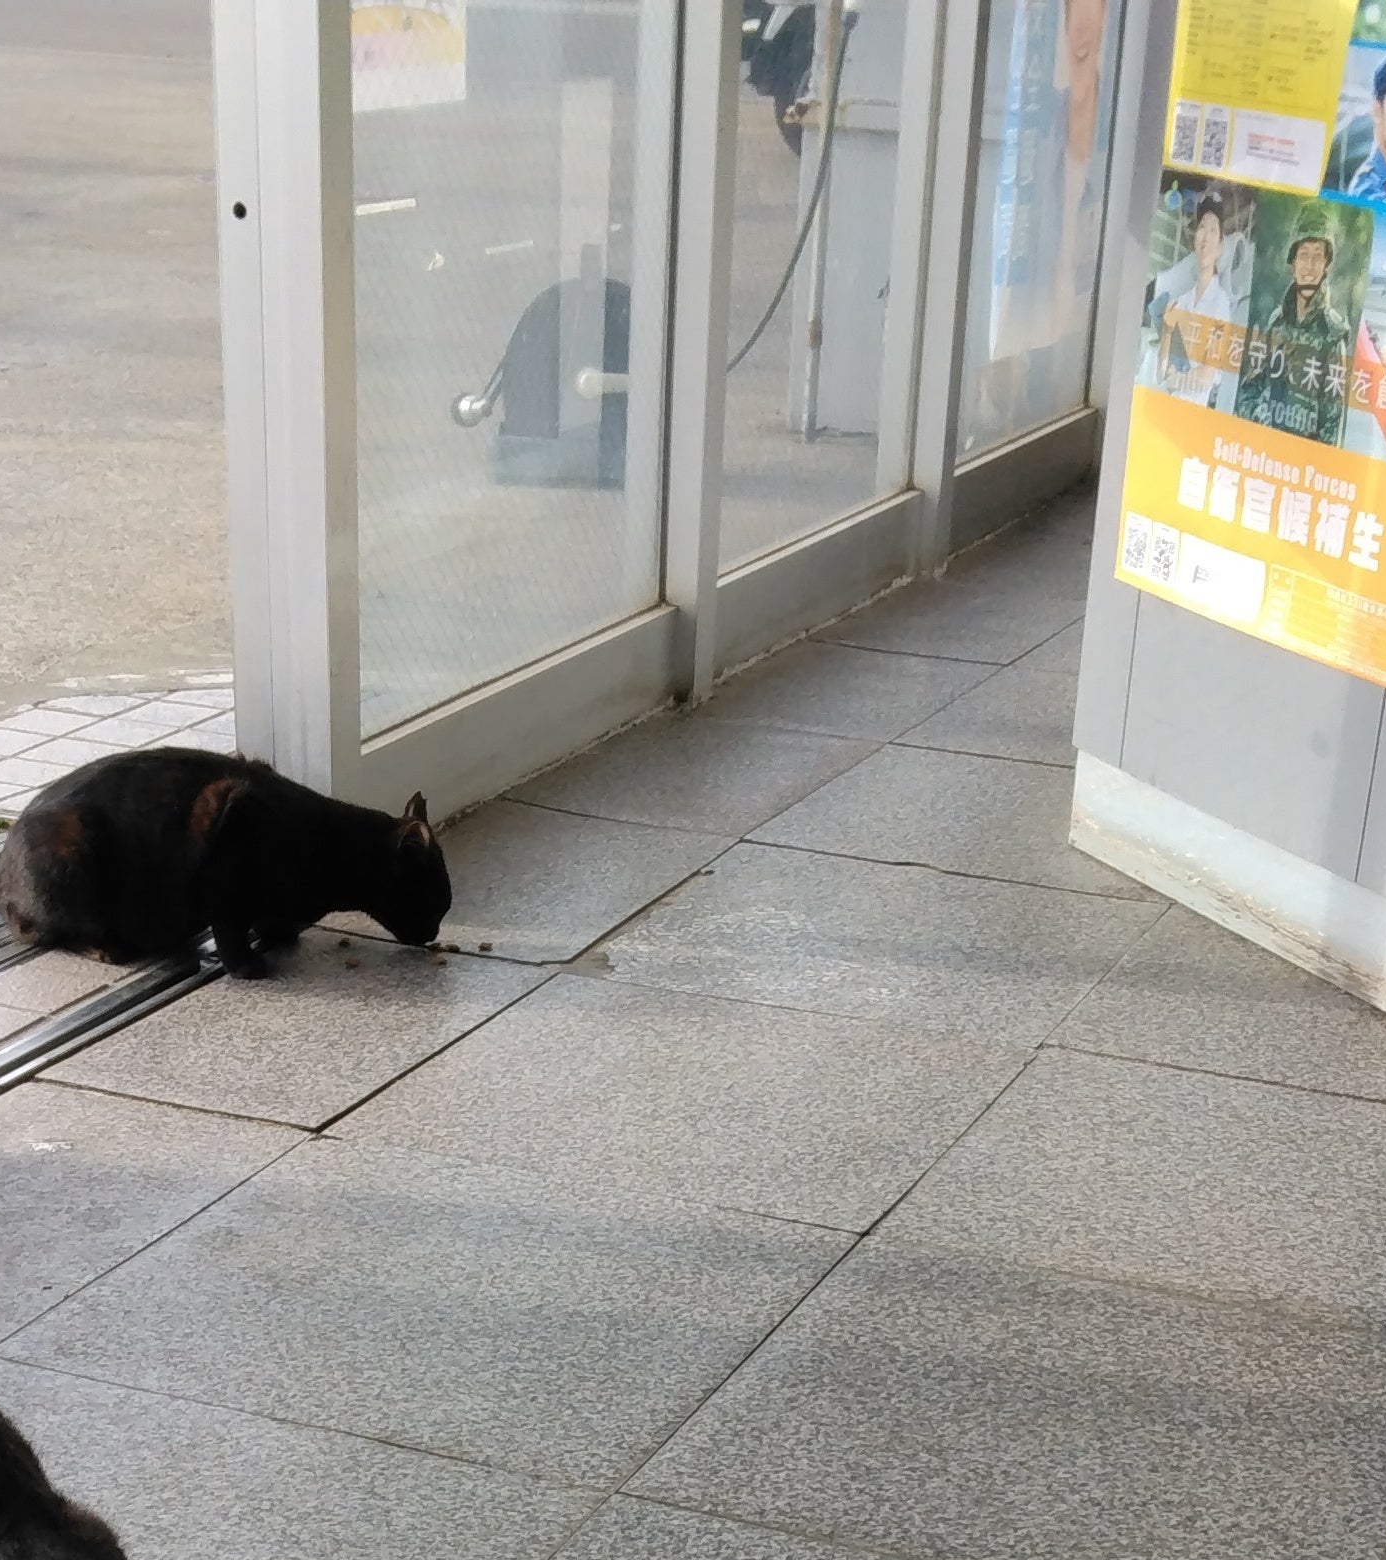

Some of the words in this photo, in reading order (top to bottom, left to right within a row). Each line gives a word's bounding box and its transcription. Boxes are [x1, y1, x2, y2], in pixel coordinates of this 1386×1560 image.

[1176, 456, 1385, 573] 自衛官候補生
